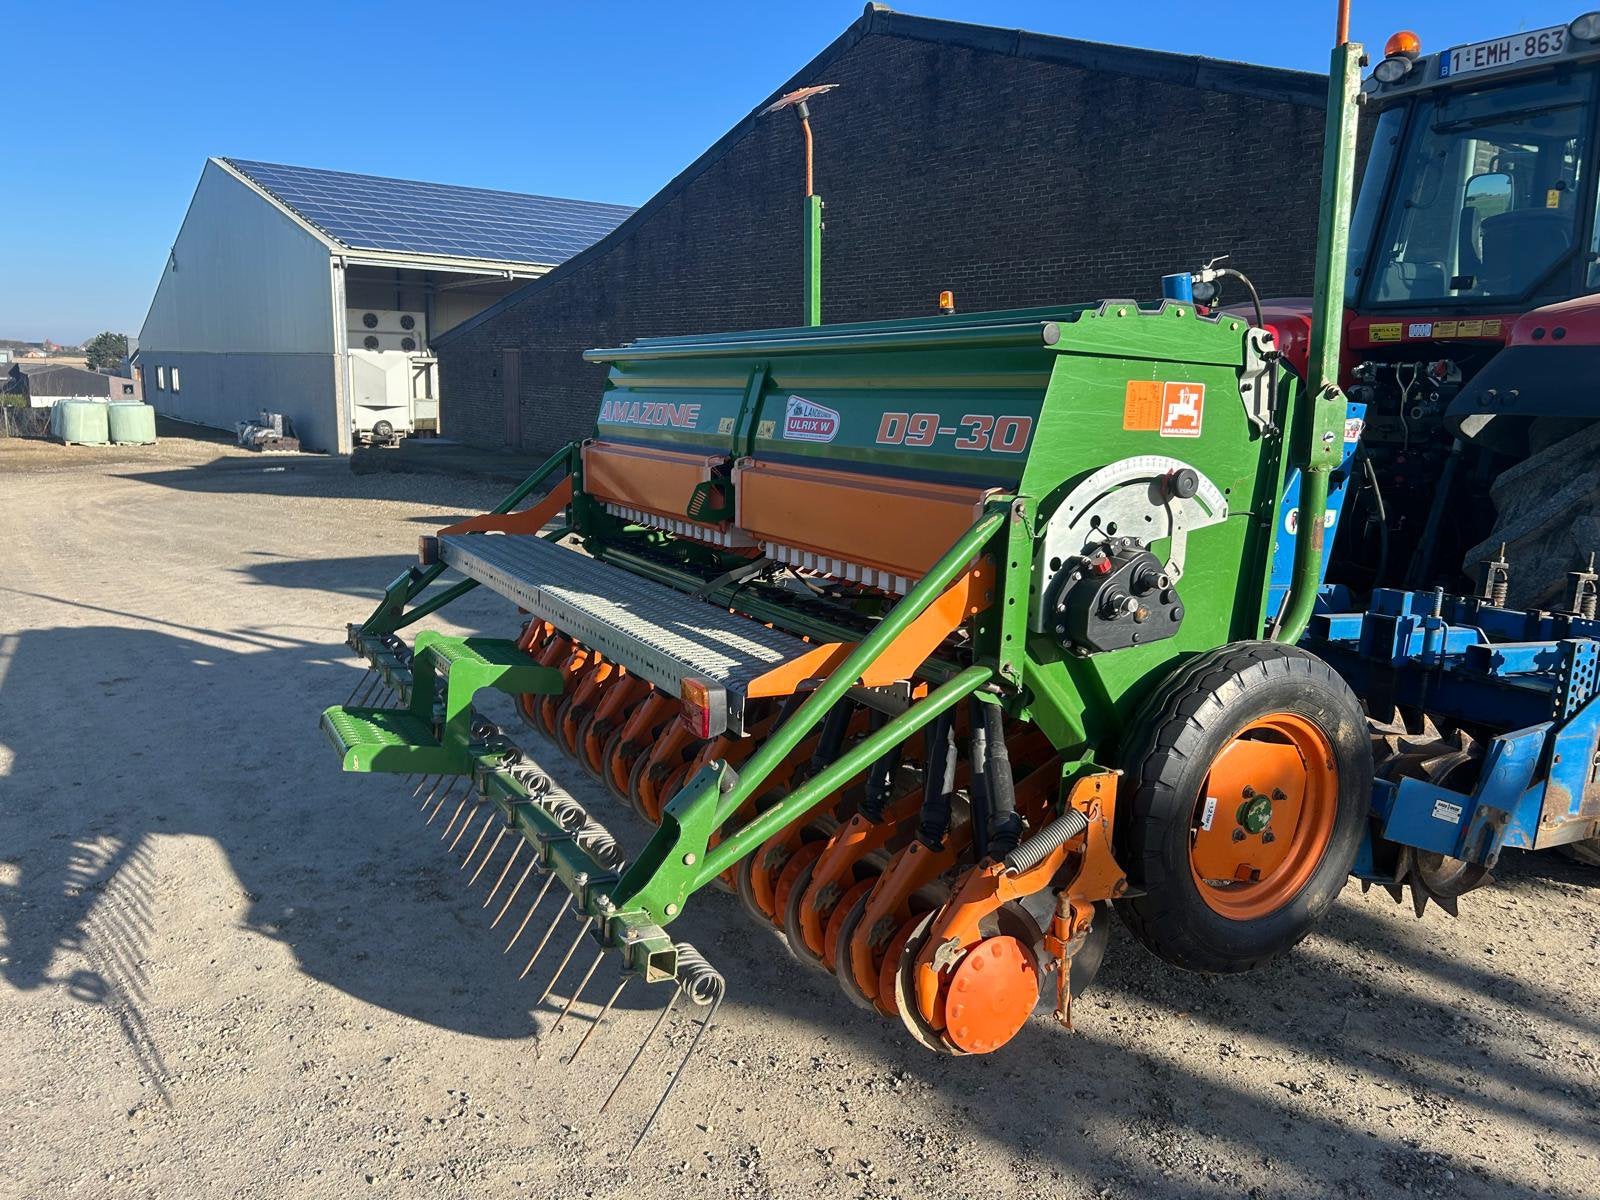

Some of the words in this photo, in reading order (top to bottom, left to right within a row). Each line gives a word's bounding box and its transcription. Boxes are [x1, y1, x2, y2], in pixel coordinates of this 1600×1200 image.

[1453, 30, 1564, 71] 1-EMH-863
[1441, 66, 1449, 76] B
[600, 400, 702, 429] AMAZONE
[790, 419, 819, 431] ULRIX
[820, 422, 831, 432] W
[875, 411, 1033, 454] D9-30
